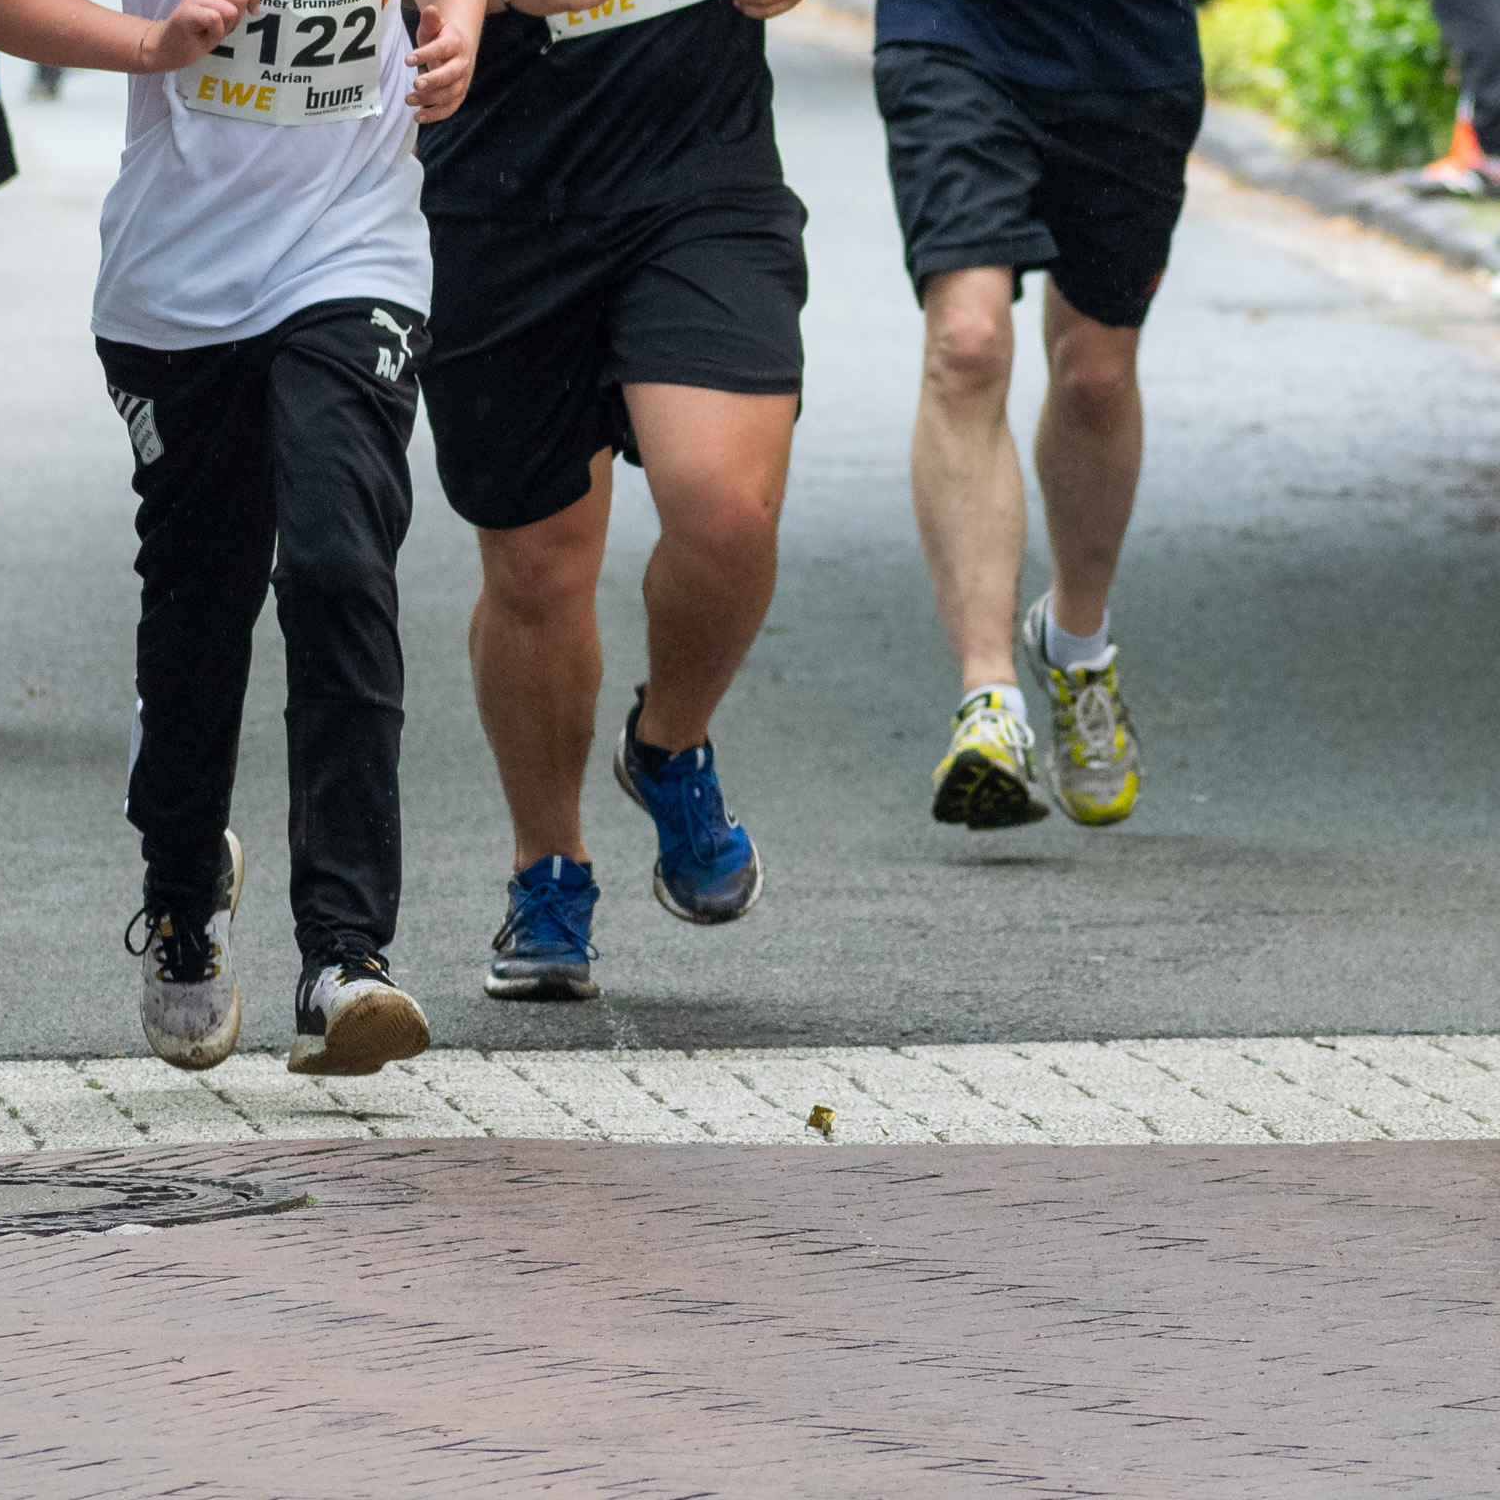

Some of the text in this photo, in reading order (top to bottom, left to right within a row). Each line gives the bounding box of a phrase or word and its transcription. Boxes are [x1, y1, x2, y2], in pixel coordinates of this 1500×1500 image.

[209, 6, 376, 68] 122
[197, 75, 276, 111] EWE
[260, 70, 312, 83] Adrian
[306, 84, 364, 109] bruns
[375, 346, 406, 383] AJ
